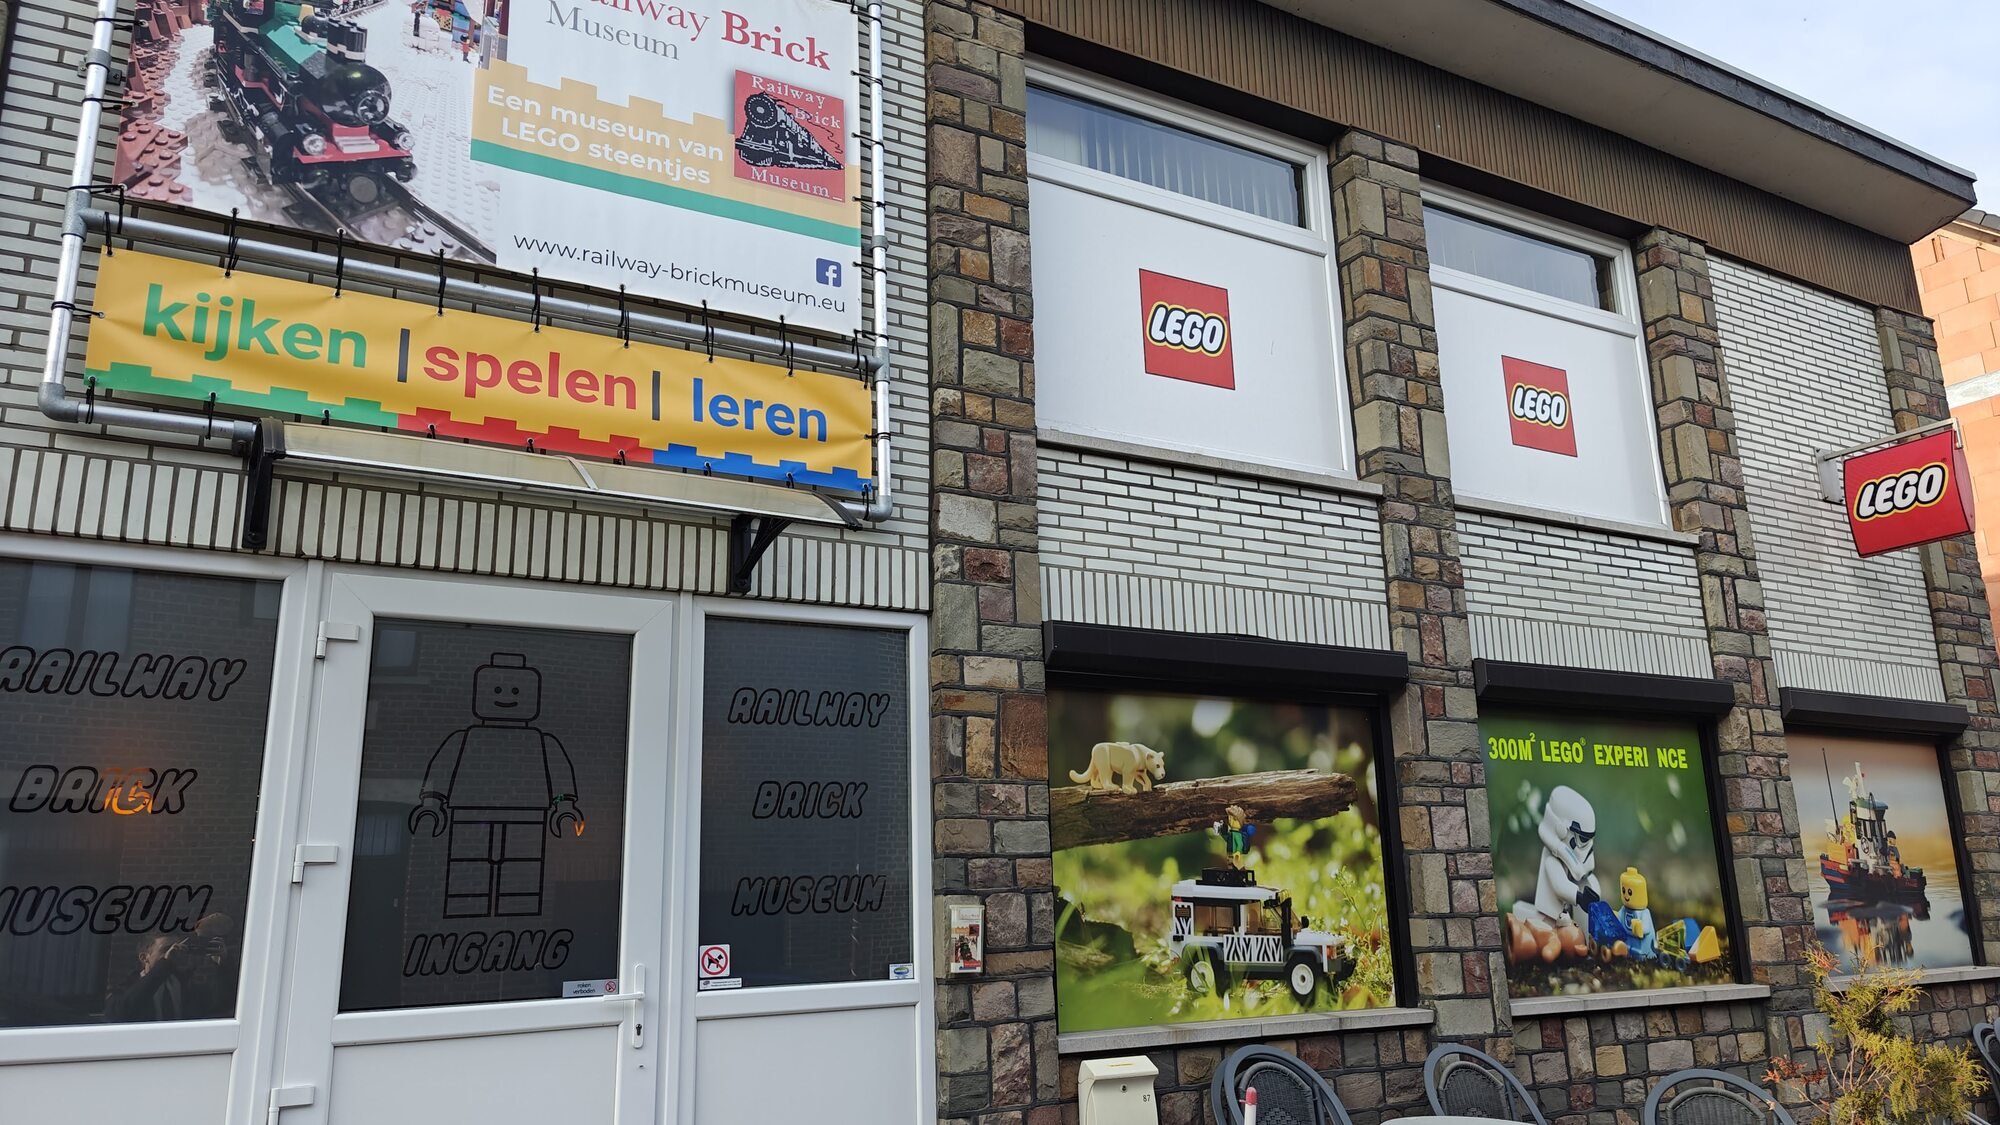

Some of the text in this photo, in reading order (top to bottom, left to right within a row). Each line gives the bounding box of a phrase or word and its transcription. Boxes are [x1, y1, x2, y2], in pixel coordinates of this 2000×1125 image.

[546, 0, 680, 60] Museum
[721, 10, 830, 70] Brick
[752, 75, 825, 109] Railway
[487, 84, 723, 162] Een museum van
[795, 108, 841, 129] Brick
[502, 117, 711, 185] LEGO steentjes
[751, 166, 830, 198] Museum
[513, 234, 846, 314] www.railway-brickmuseum.eu
[1148, 303, 1226, 356] LEGO
[142, 284, 367, 368] kijken
[423, 346, 638, 411] spelen
[692, 378, 828, 442] leren
[1512, 384, 1568, 428] LEGO
[1855, 464, 1947, 520] LEGO
[0, 645, 248, 701] RAILWAY
[727, 687, 891, 729] RAILWAY
[8, 765, 198, 815] BRICK
[751, 781, 869, 819] BRICK
[731, 874, 888, 917] MUSEUM
[402, 929, 575, 978] INGANG
[1142, 1094, 1151, 1102] 87
